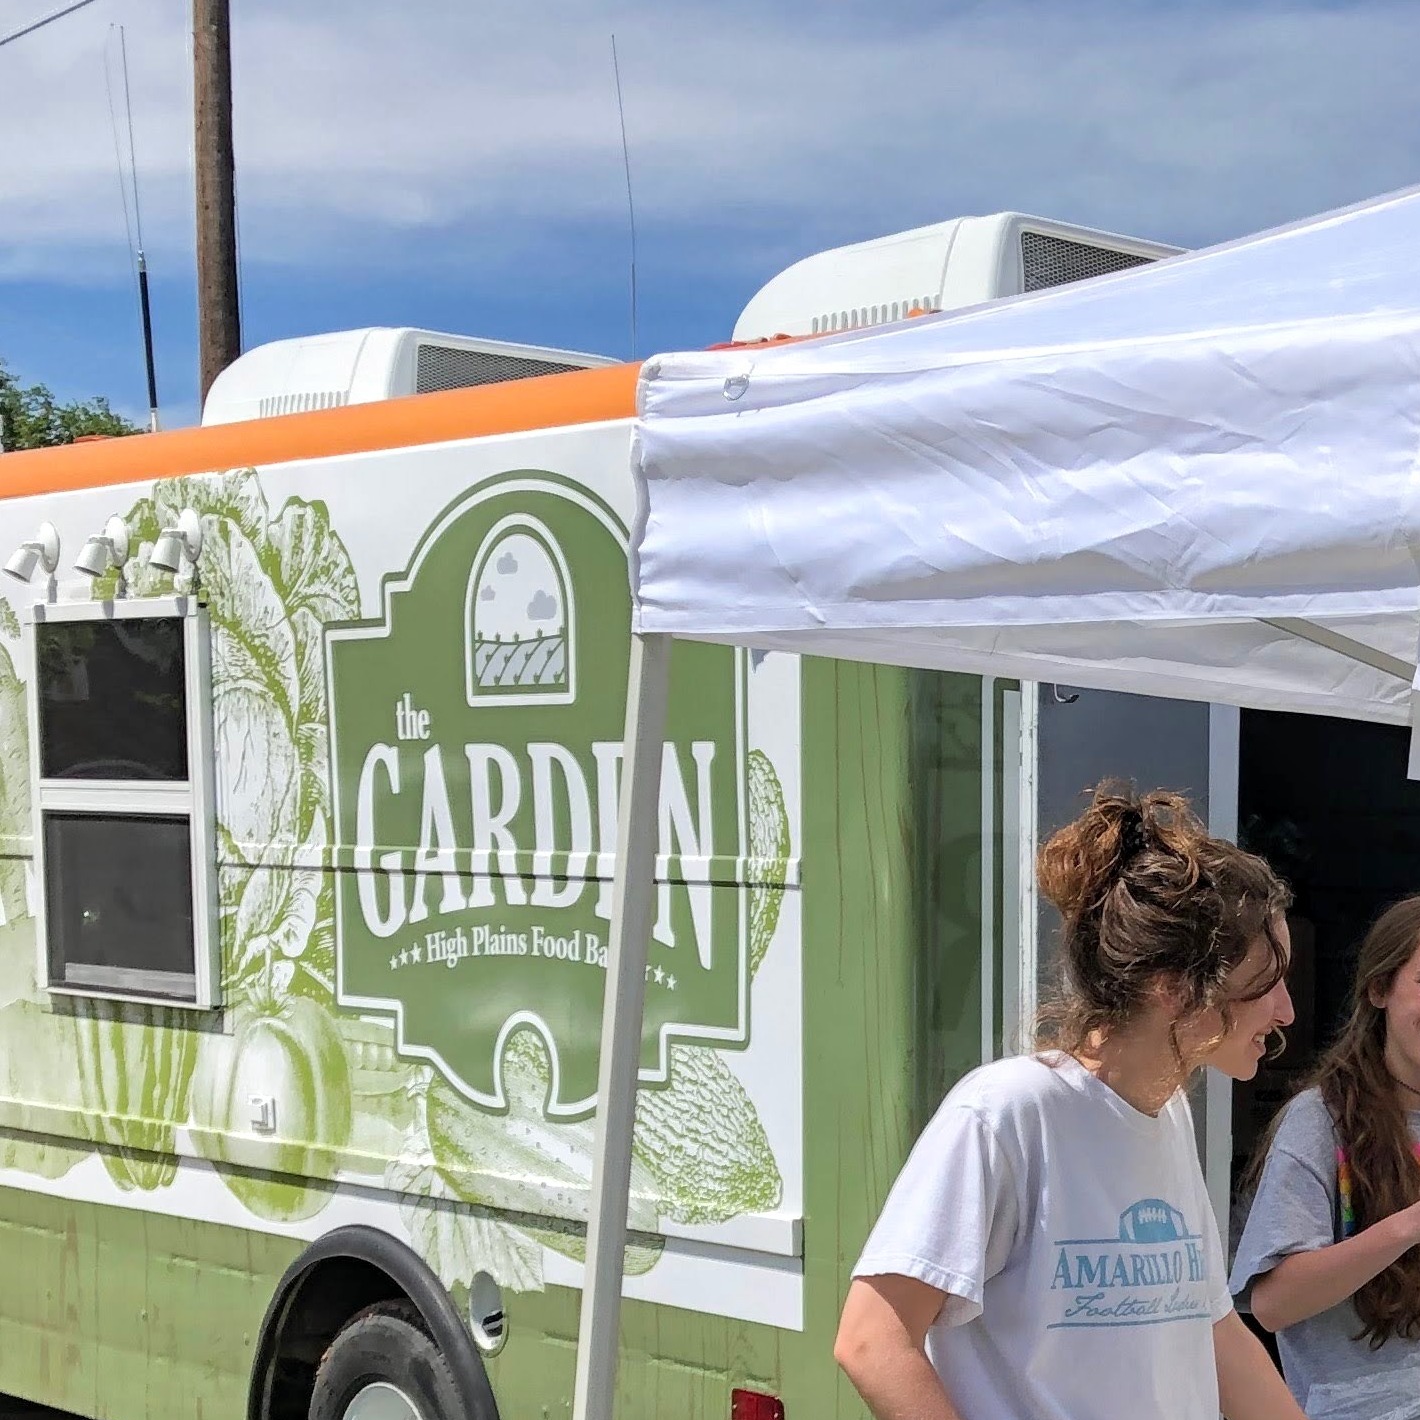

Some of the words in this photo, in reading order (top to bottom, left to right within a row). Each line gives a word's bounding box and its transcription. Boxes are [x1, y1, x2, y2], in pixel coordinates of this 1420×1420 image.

[396, 693, 430, 740] the
[425, 933, 468, 968] High
[472, 926, 528, 957] Plains
[531, 926, 580, 959] Food
[584, 935, 609, 967] Ba
[1051, 1247, 1183, 1290] AMARILLO
[1065, 1292, 1160, 1318] Football
